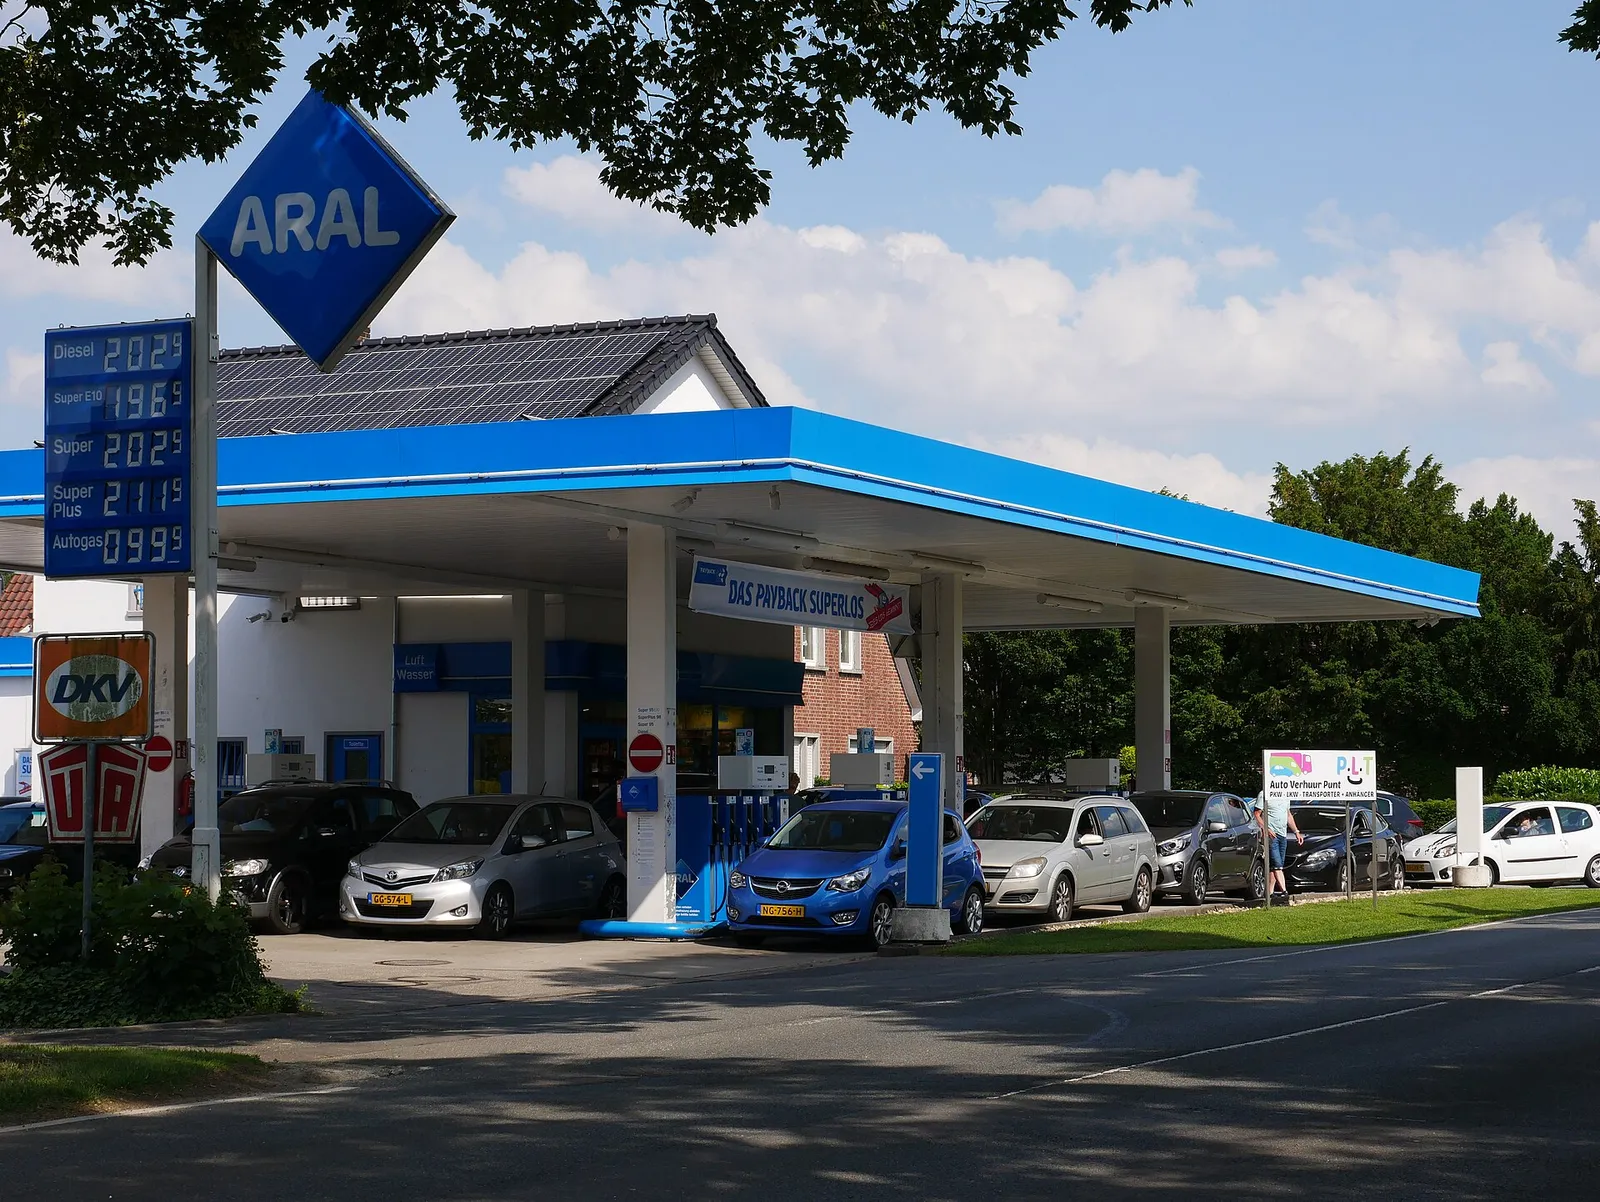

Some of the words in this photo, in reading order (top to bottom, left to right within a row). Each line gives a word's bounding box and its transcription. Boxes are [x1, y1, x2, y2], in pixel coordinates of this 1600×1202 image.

[230, 186, 400, 257] ARAL
[54, 342, 94, 360] Diesel
[54, 392, 83, 405] Super
[85, 390, 103, 402] E10
[53, 438, 94, 456] Super
[53, 484, 94, 502] Super
[53, 502, 82, 518] Plus
[53, 533, 103, 551] Autogas
[728, 580, 754, 606] DAS
[755, 583, 808, 613] PAYBACK
[809, 590, 865, 620] SUPERLOS
[405, 654, 425, 666] Luft
[396, 669, 434, 680] Wasser
[53, 673, 136, 704] DKV
[1270, 780, 1289, 789] Auto
[1290, 780, 1322, 789] Verhuur
[1323, 780, 1341, 789] Punt
[676, 873, 695, 883] RAL
[374, 894, 409, 904] GG-574-L
[762, 906, 802, 916] NG-756-H
